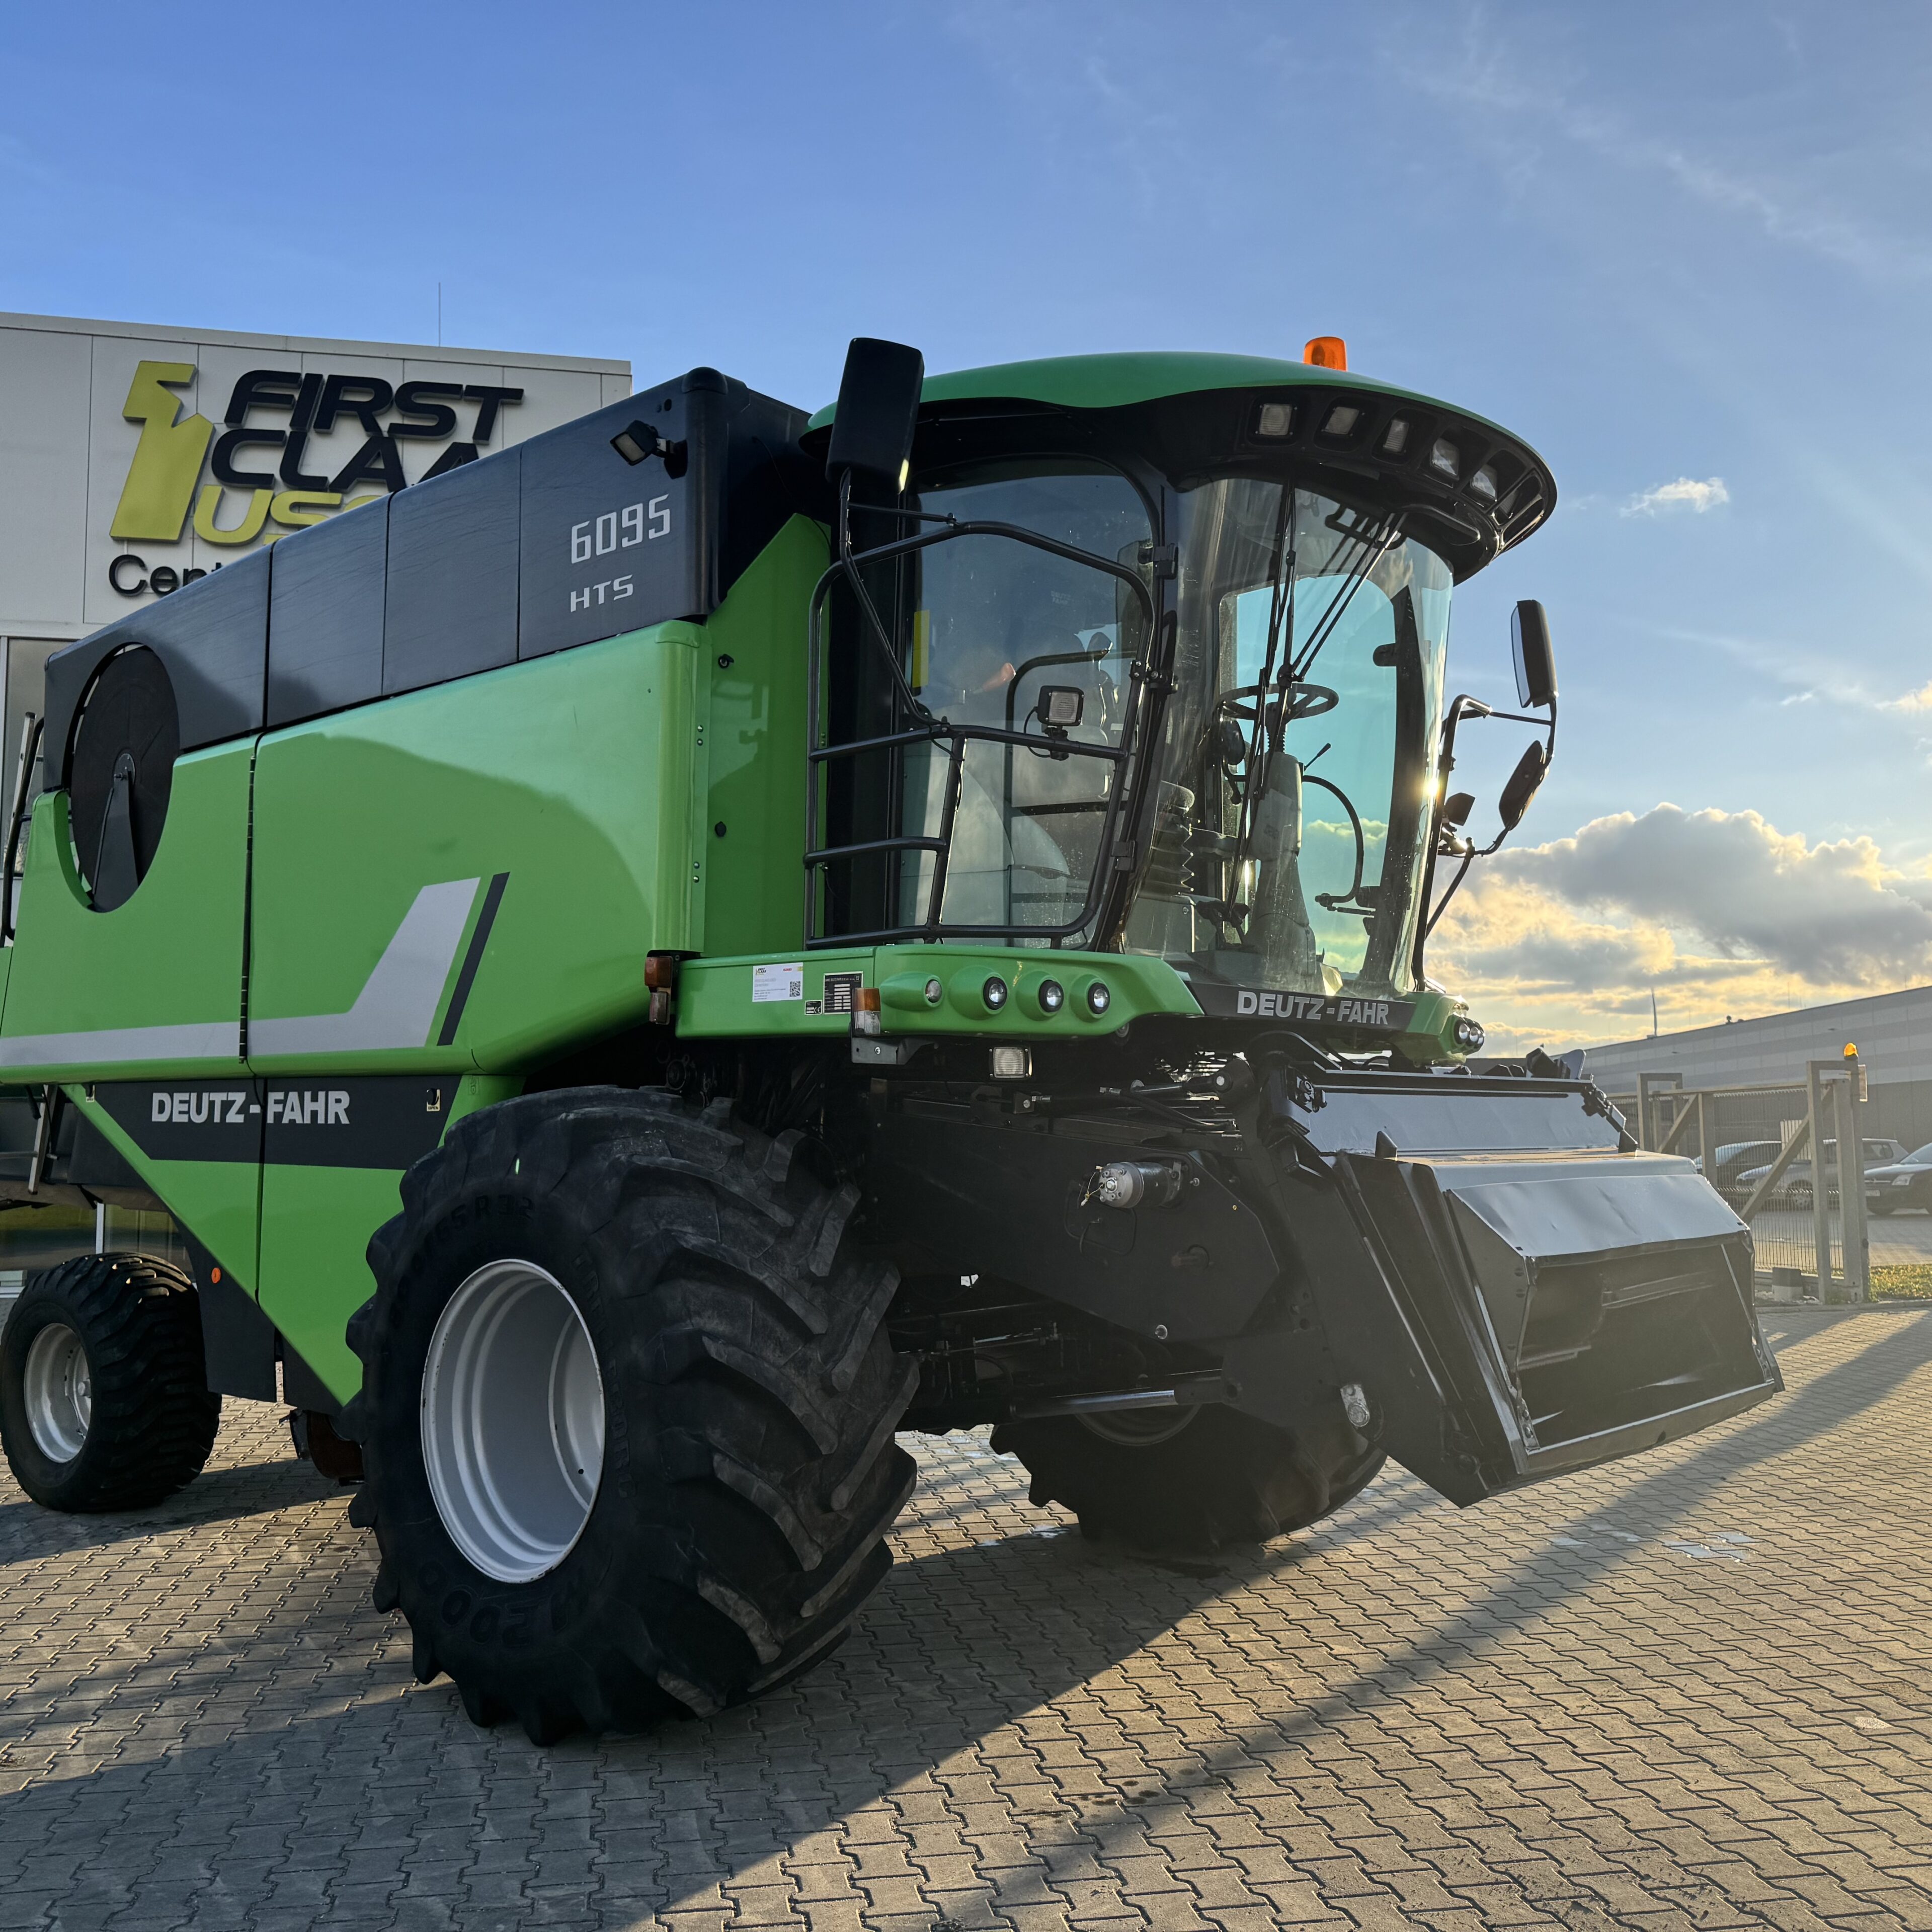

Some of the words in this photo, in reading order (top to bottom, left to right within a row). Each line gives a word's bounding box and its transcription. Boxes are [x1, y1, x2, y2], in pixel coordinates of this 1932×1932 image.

[224, 369, 524, 444] FIRST
[193, 485, 381, 546] US
[571, 494, 670, 564] 6095
[571, 574, 633, 612] HTS
